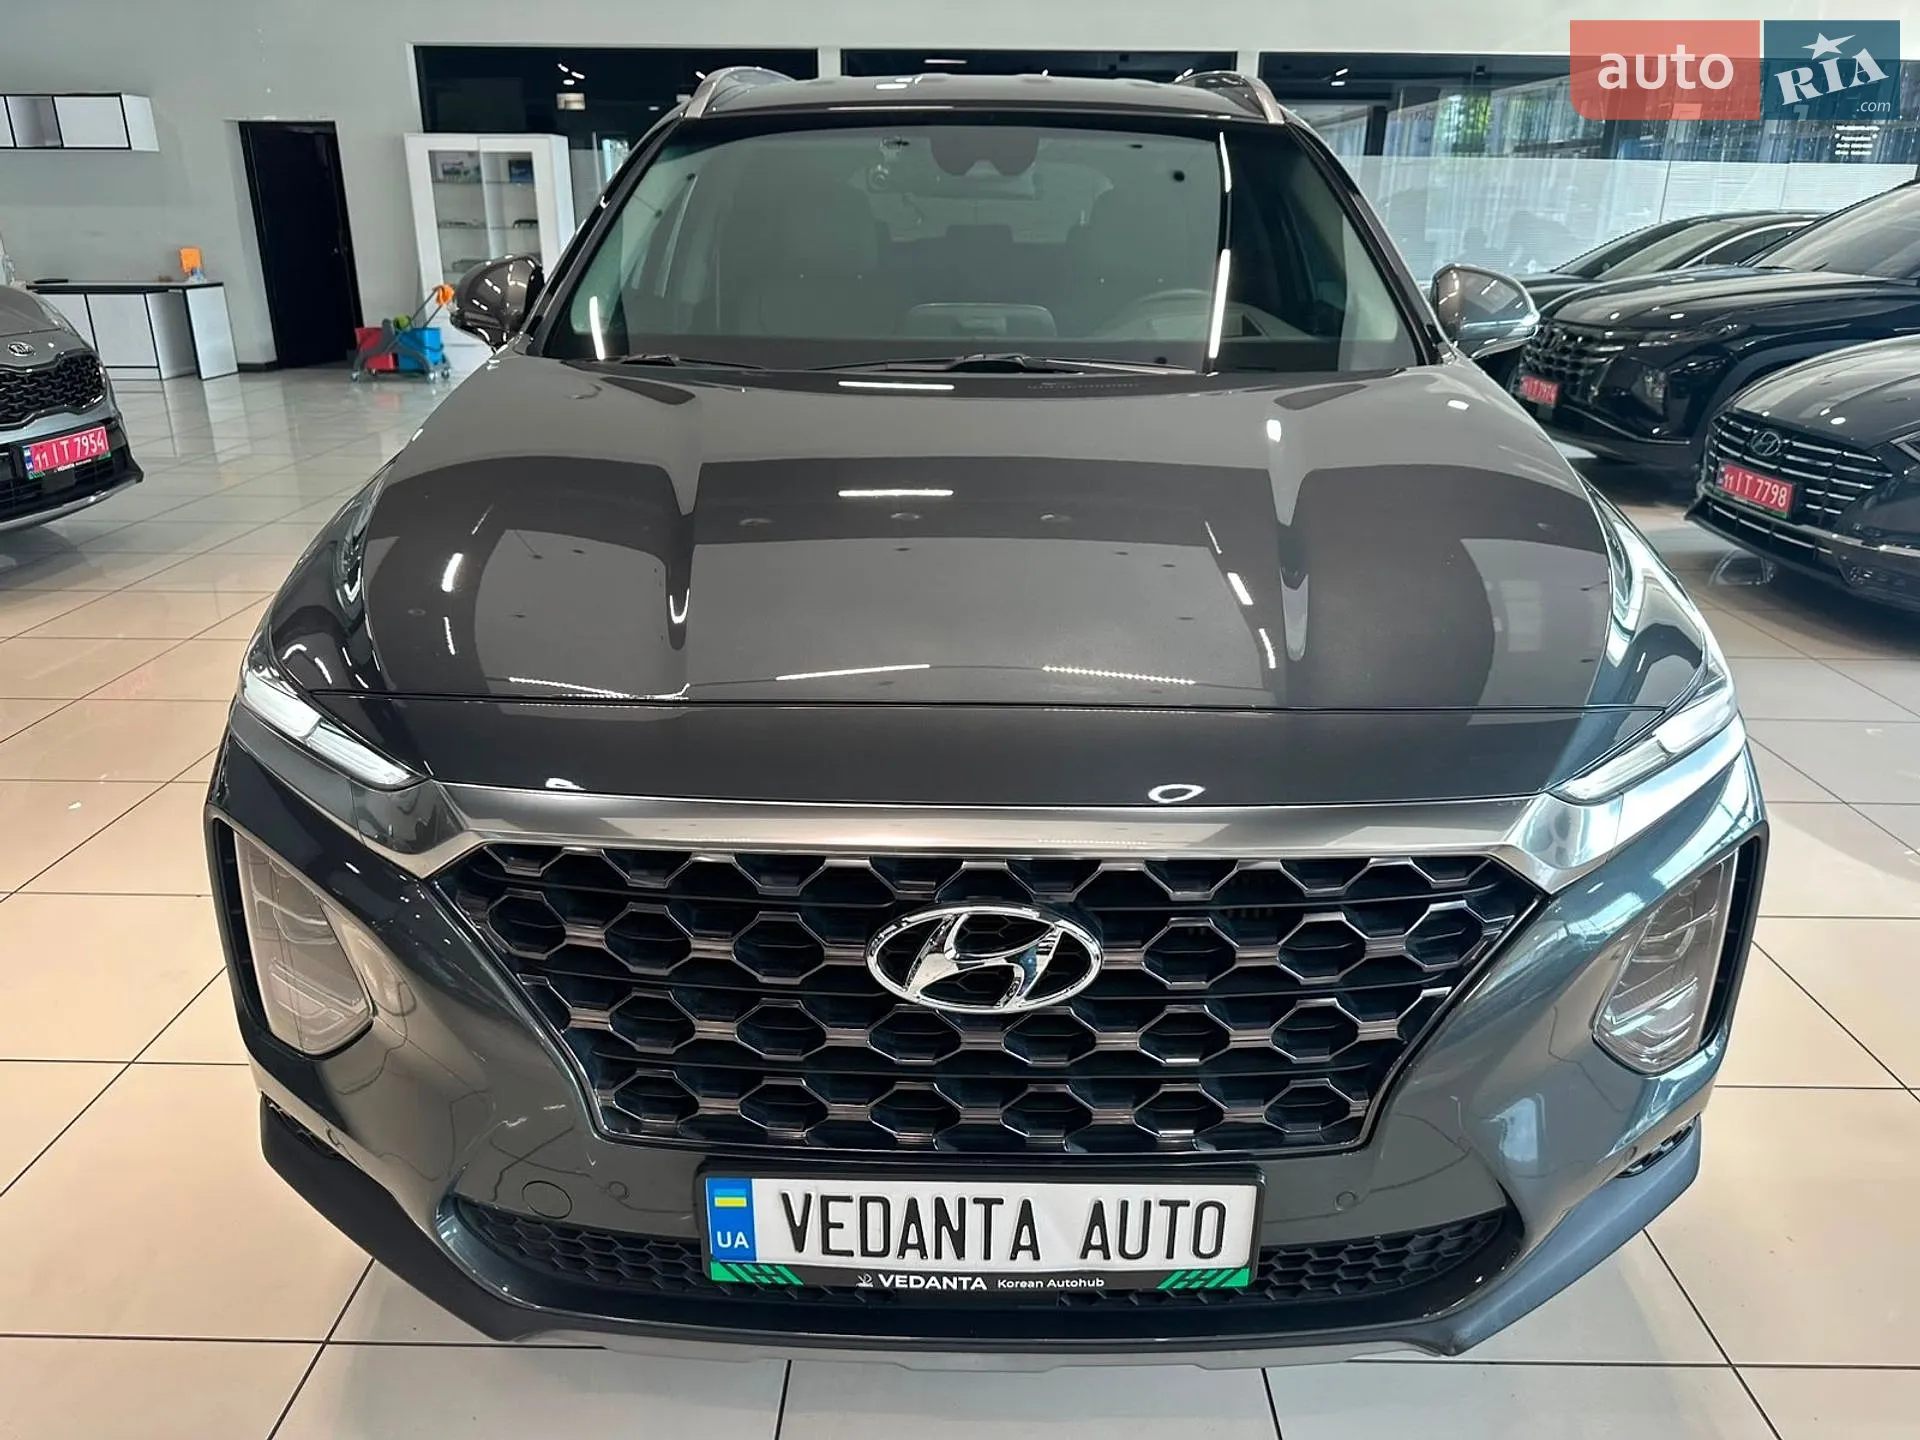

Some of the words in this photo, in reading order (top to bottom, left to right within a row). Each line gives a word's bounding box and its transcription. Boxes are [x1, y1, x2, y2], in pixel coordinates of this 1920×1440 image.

[75, 432, 105, 458] 7954
[1754, 479, 1787, 507] 7798
[780, 1193, 1041, 1261] VEDANTA
[1079, 1199, 1227, 1261] AUTO
[717, 1231, 749, 1249] UA
[878, 1273, 988, 1291] VEDANTA
[997, 1278, 1044, 1289] Korean
[1046, 1277, 1105, 1289] Autohub
